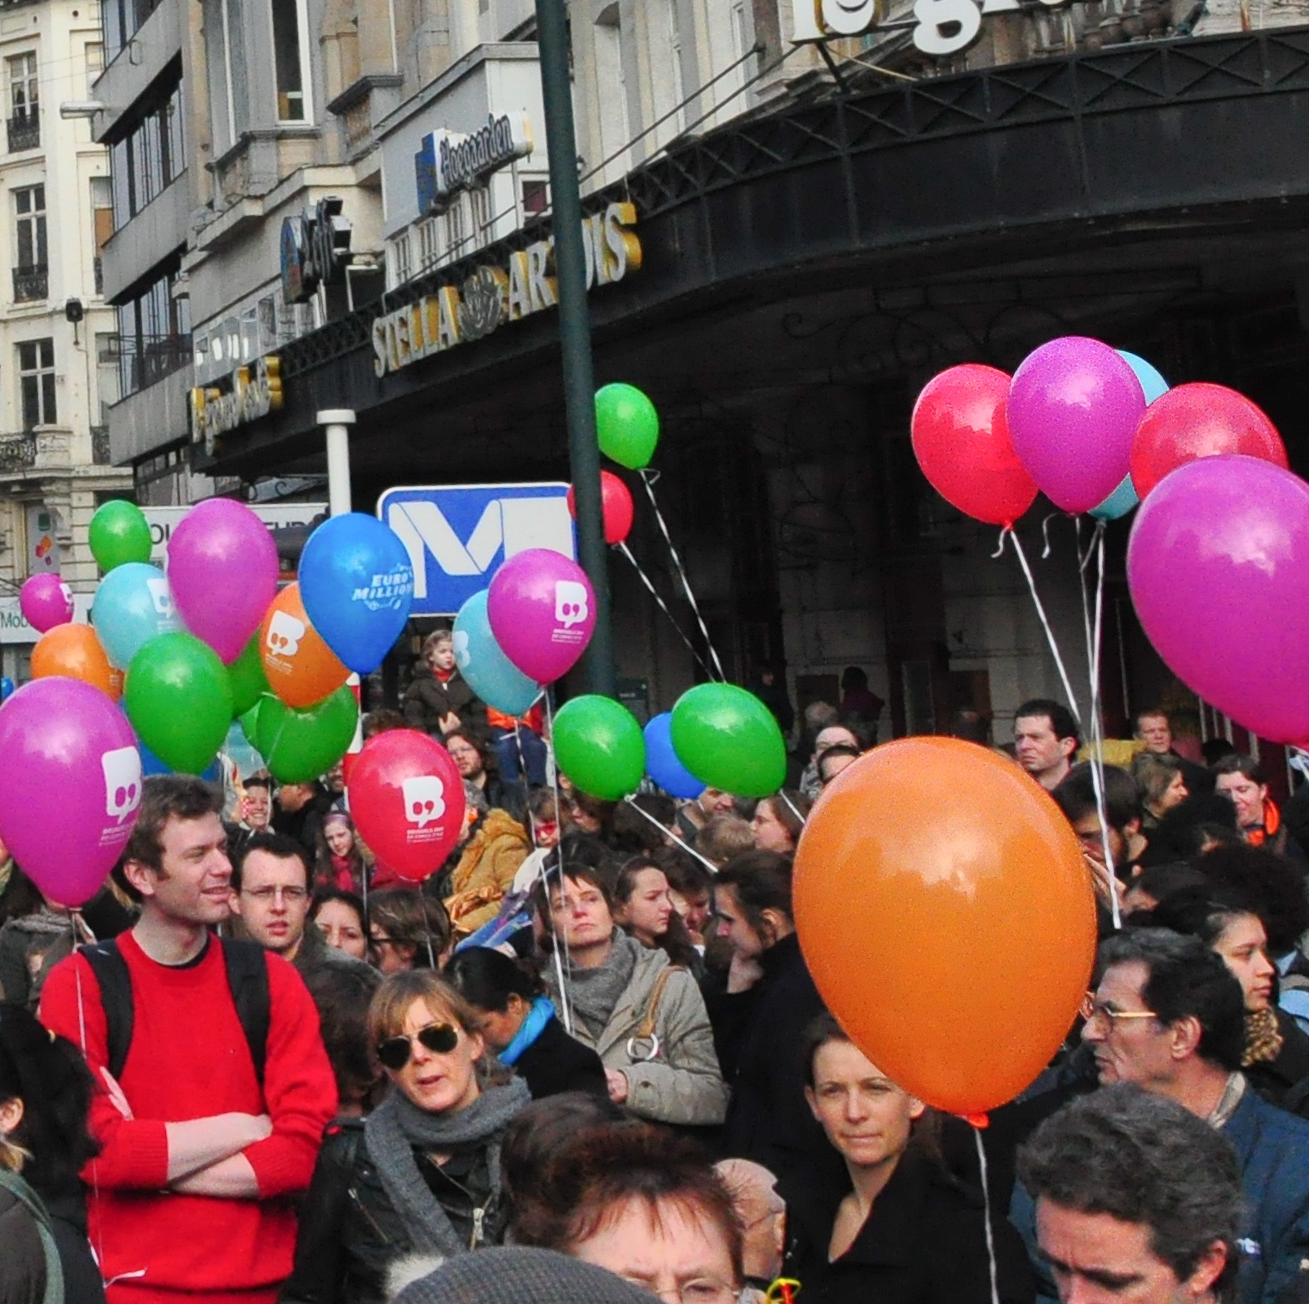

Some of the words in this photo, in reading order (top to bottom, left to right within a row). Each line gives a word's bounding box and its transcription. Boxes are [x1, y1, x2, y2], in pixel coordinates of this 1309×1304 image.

[440, 112, 514, 190] Hoegaarden
[373, 284, 462, 378] STELLA
[370, 572, 409, 587] EURO
